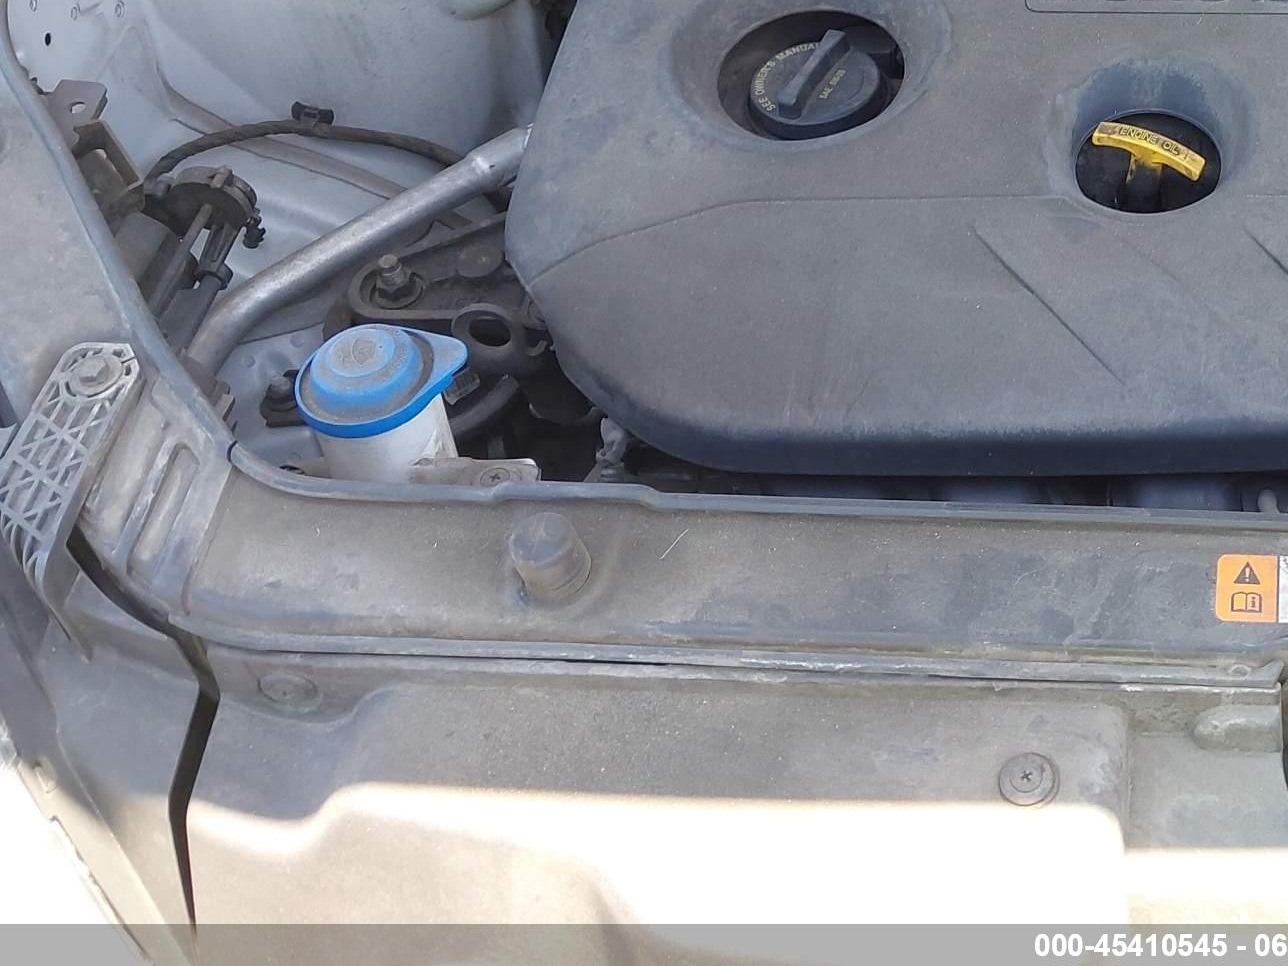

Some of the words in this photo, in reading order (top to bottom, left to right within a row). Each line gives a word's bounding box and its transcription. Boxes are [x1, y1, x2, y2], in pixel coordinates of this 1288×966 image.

[754, 60, 777, 96] OWNER'S
[758, 96, 777, 112] SEE
[819, 86, 834, 100] SAE
[1119, 126, 1158, 146] ENGINE
[1162, 140, 1179, 155] OIL
